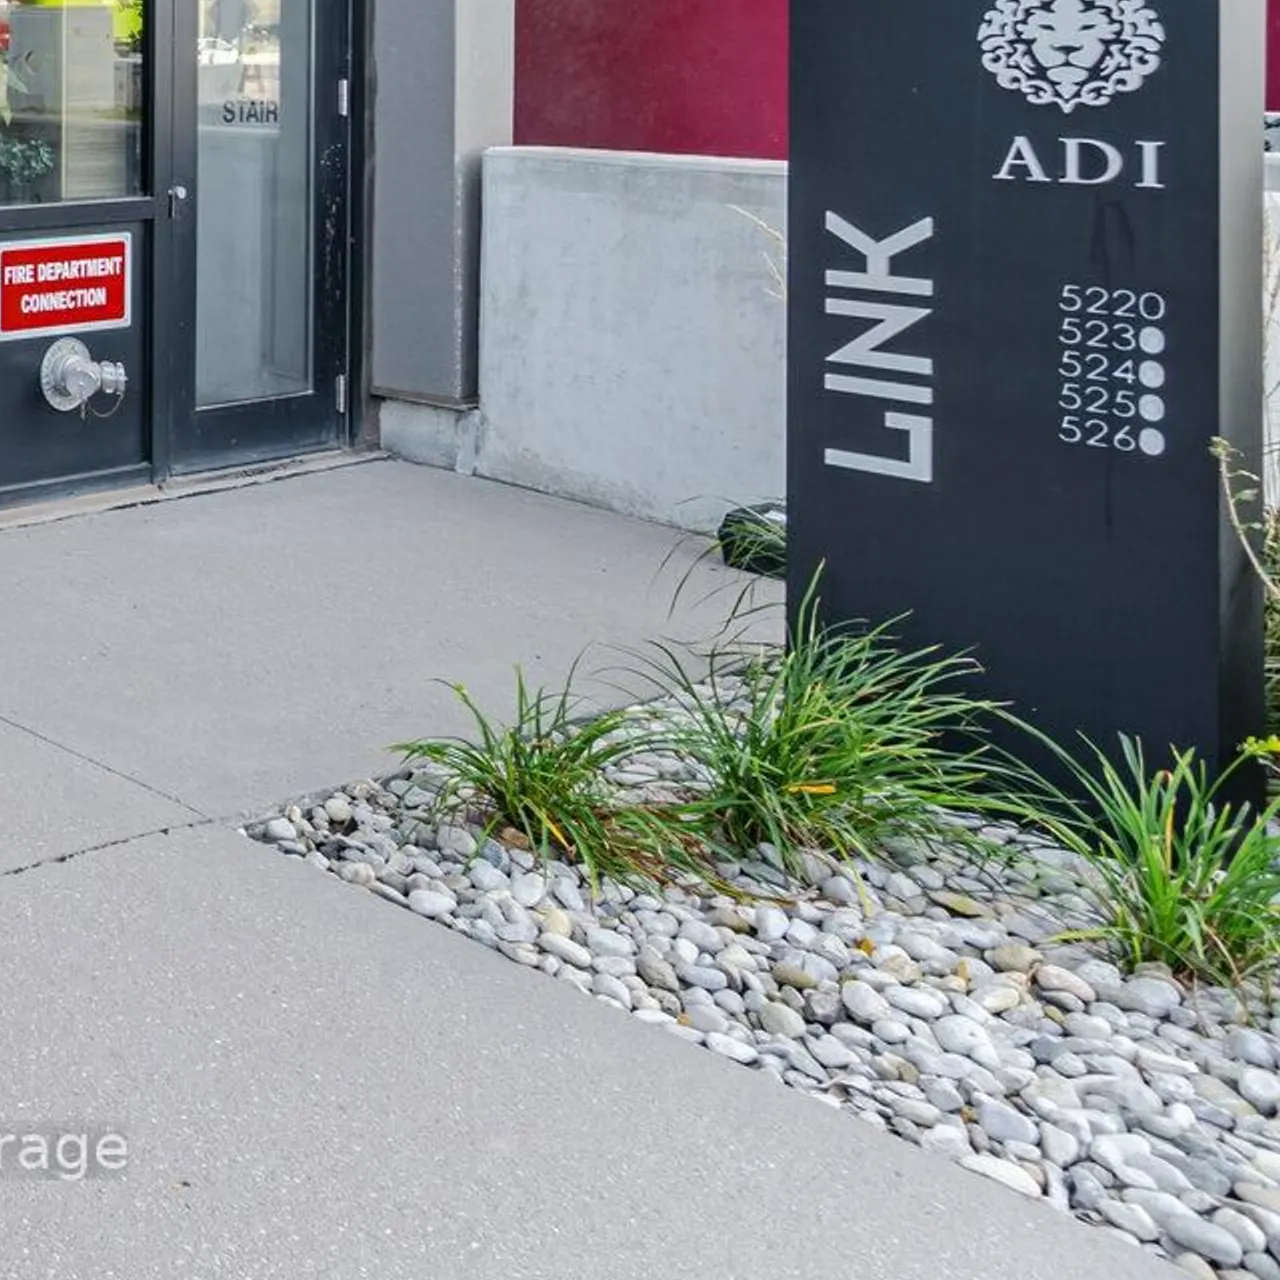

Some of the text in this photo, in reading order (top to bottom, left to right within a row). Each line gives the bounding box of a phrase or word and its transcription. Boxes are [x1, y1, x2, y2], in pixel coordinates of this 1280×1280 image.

[222, 99, 279, 124] STAIR
[991, 135, 1166, 188] ADI
[3, 256, 123, 286] FIRE DEPARTMENT
[20, 286, 107, 314] CONNECTION
[1058, 284, 1166, 321] 5220
[824, 209, 934, 483] LINK
